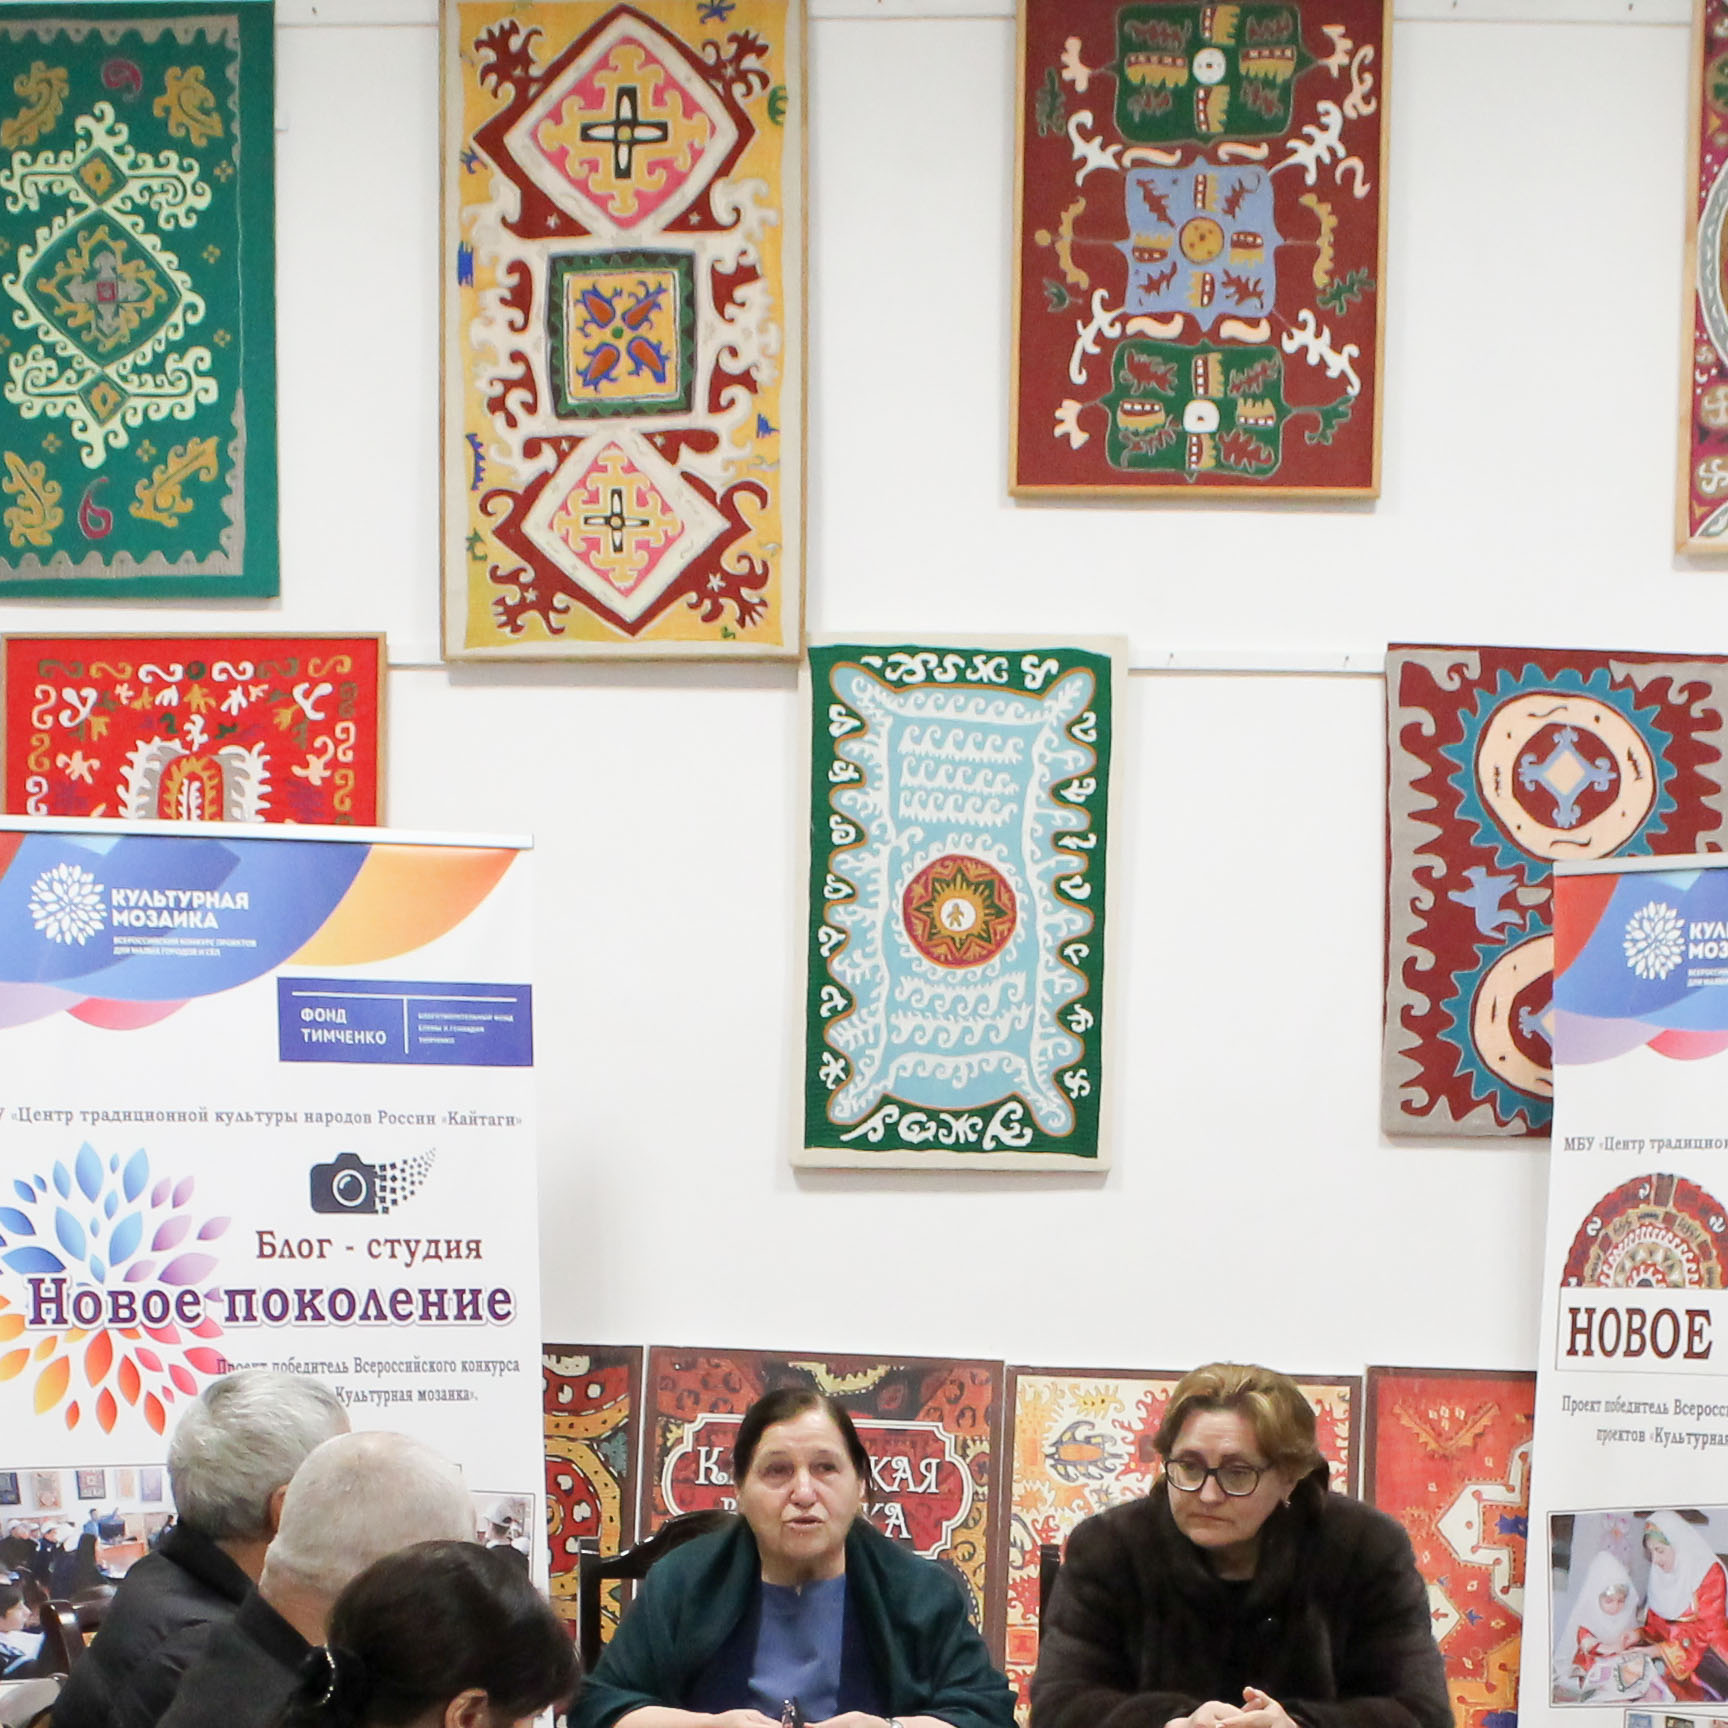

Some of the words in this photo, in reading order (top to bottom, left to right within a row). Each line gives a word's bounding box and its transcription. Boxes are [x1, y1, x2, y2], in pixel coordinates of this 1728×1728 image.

[111, 887, 249, 911] КУЛЬТУРНАЯ
[112, 908, 219, 930] МОЗАИКА
[300, 1007, 348, 1025] ФОНД
[300, 1028, 387, 1045] ТИМЧЕНКО
[80, 1107, 209, 1126] традиционной
[215, 1109, 298, 1127] культуры
[304, 1110, 372, 1128] народов
[377, 1110, 436, 1126] России
[1564, 1136, 1595, 1152] МБУ
[255, 1231, 333, 1260] Блог
[367, 1237, 483, 1268] студия
[25, 1276, 203, 1326] Новое
[223, 1286, 513, 1323] поколение
[1565, 1306, 1714, 1360] НОВОЕ
[272, 1357, 349, 1374] победитель
[354, 1356, 457, 1379] Всероссийского
[460, 1359, 521, 1380] конкурса
[1562, 1395, 1602, 1413] Проект
[1604, 1395, 1669, 1415] победитель
[1596, 1427, 1646, 1446] проектов
